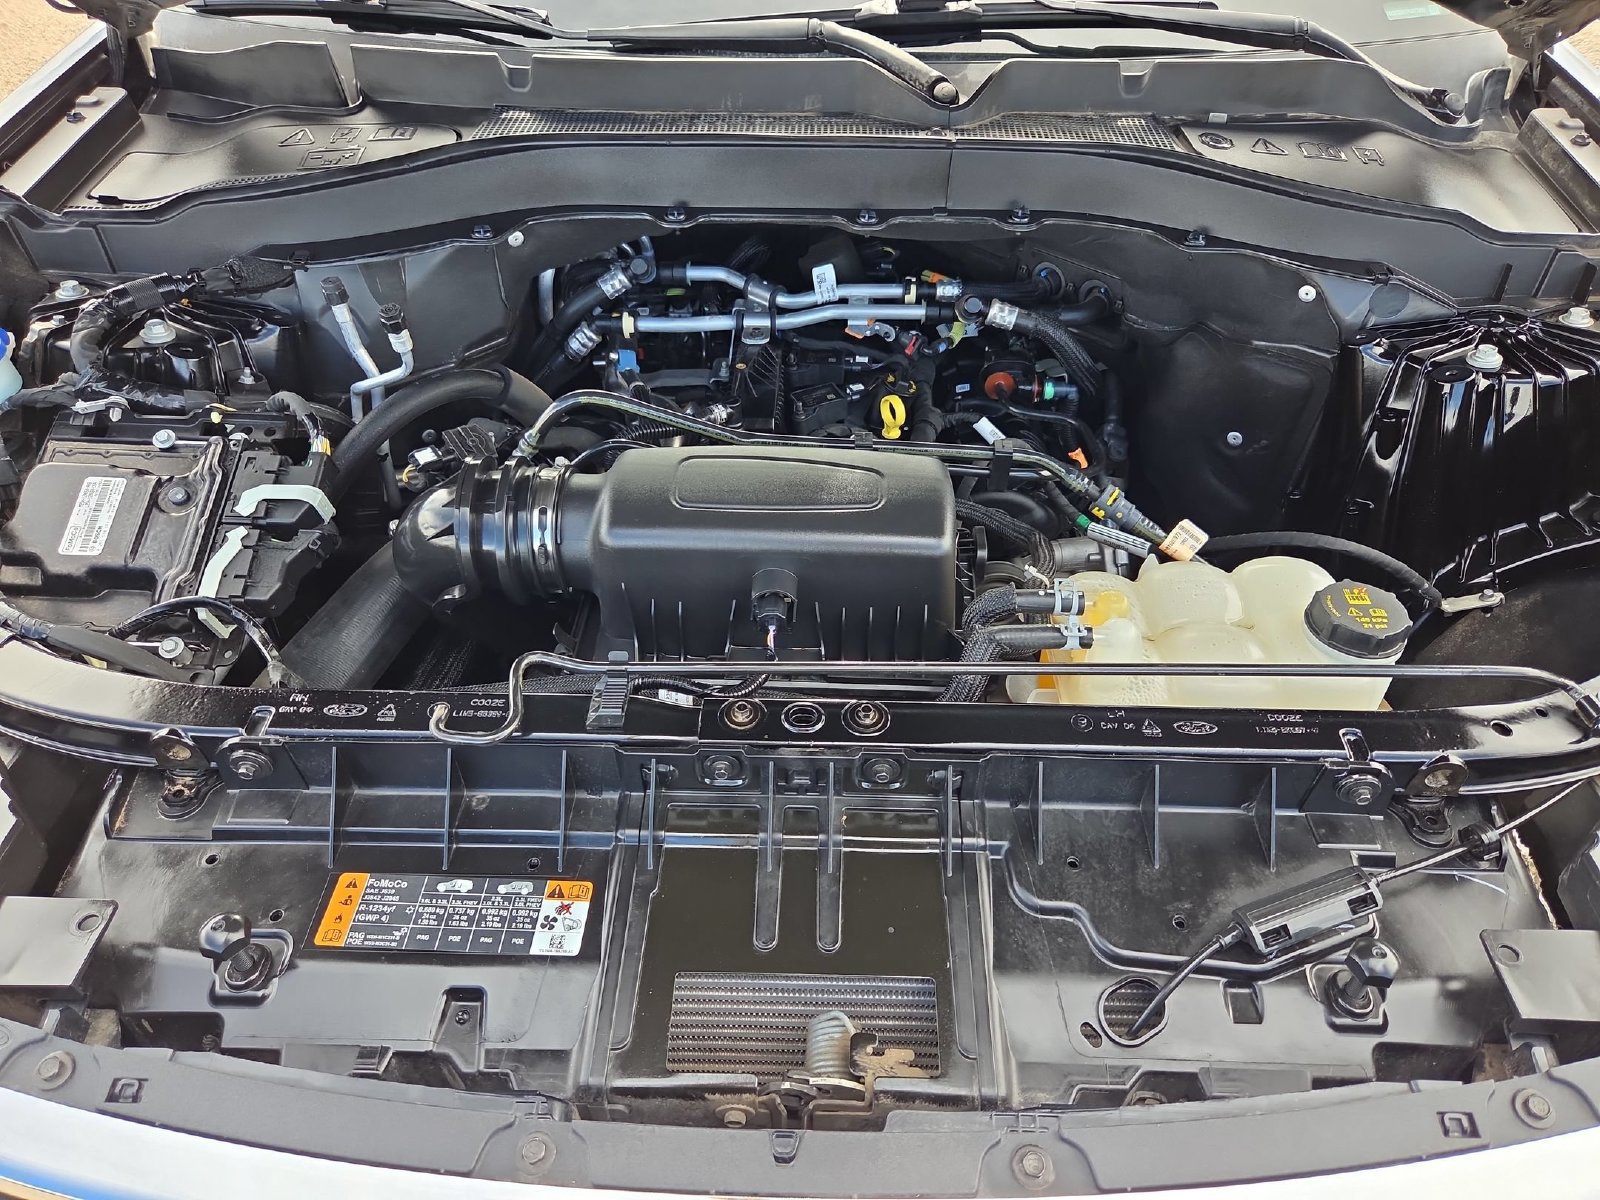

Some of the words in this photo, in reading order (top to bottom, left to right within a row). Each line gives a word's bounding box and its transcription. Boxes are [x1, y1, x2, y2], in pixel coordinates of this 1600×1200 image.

[367, 879, 408, 888] FoMoCo
[359, 904, 396, 913] R-1234yf
[436, 907, 445, 915] kg
[467, 908, 475, 916] kg
[530, 910, 538, 918] kg
[355, 913, 380, 922] (GWP
[380, 914, 390, 924] 4)
